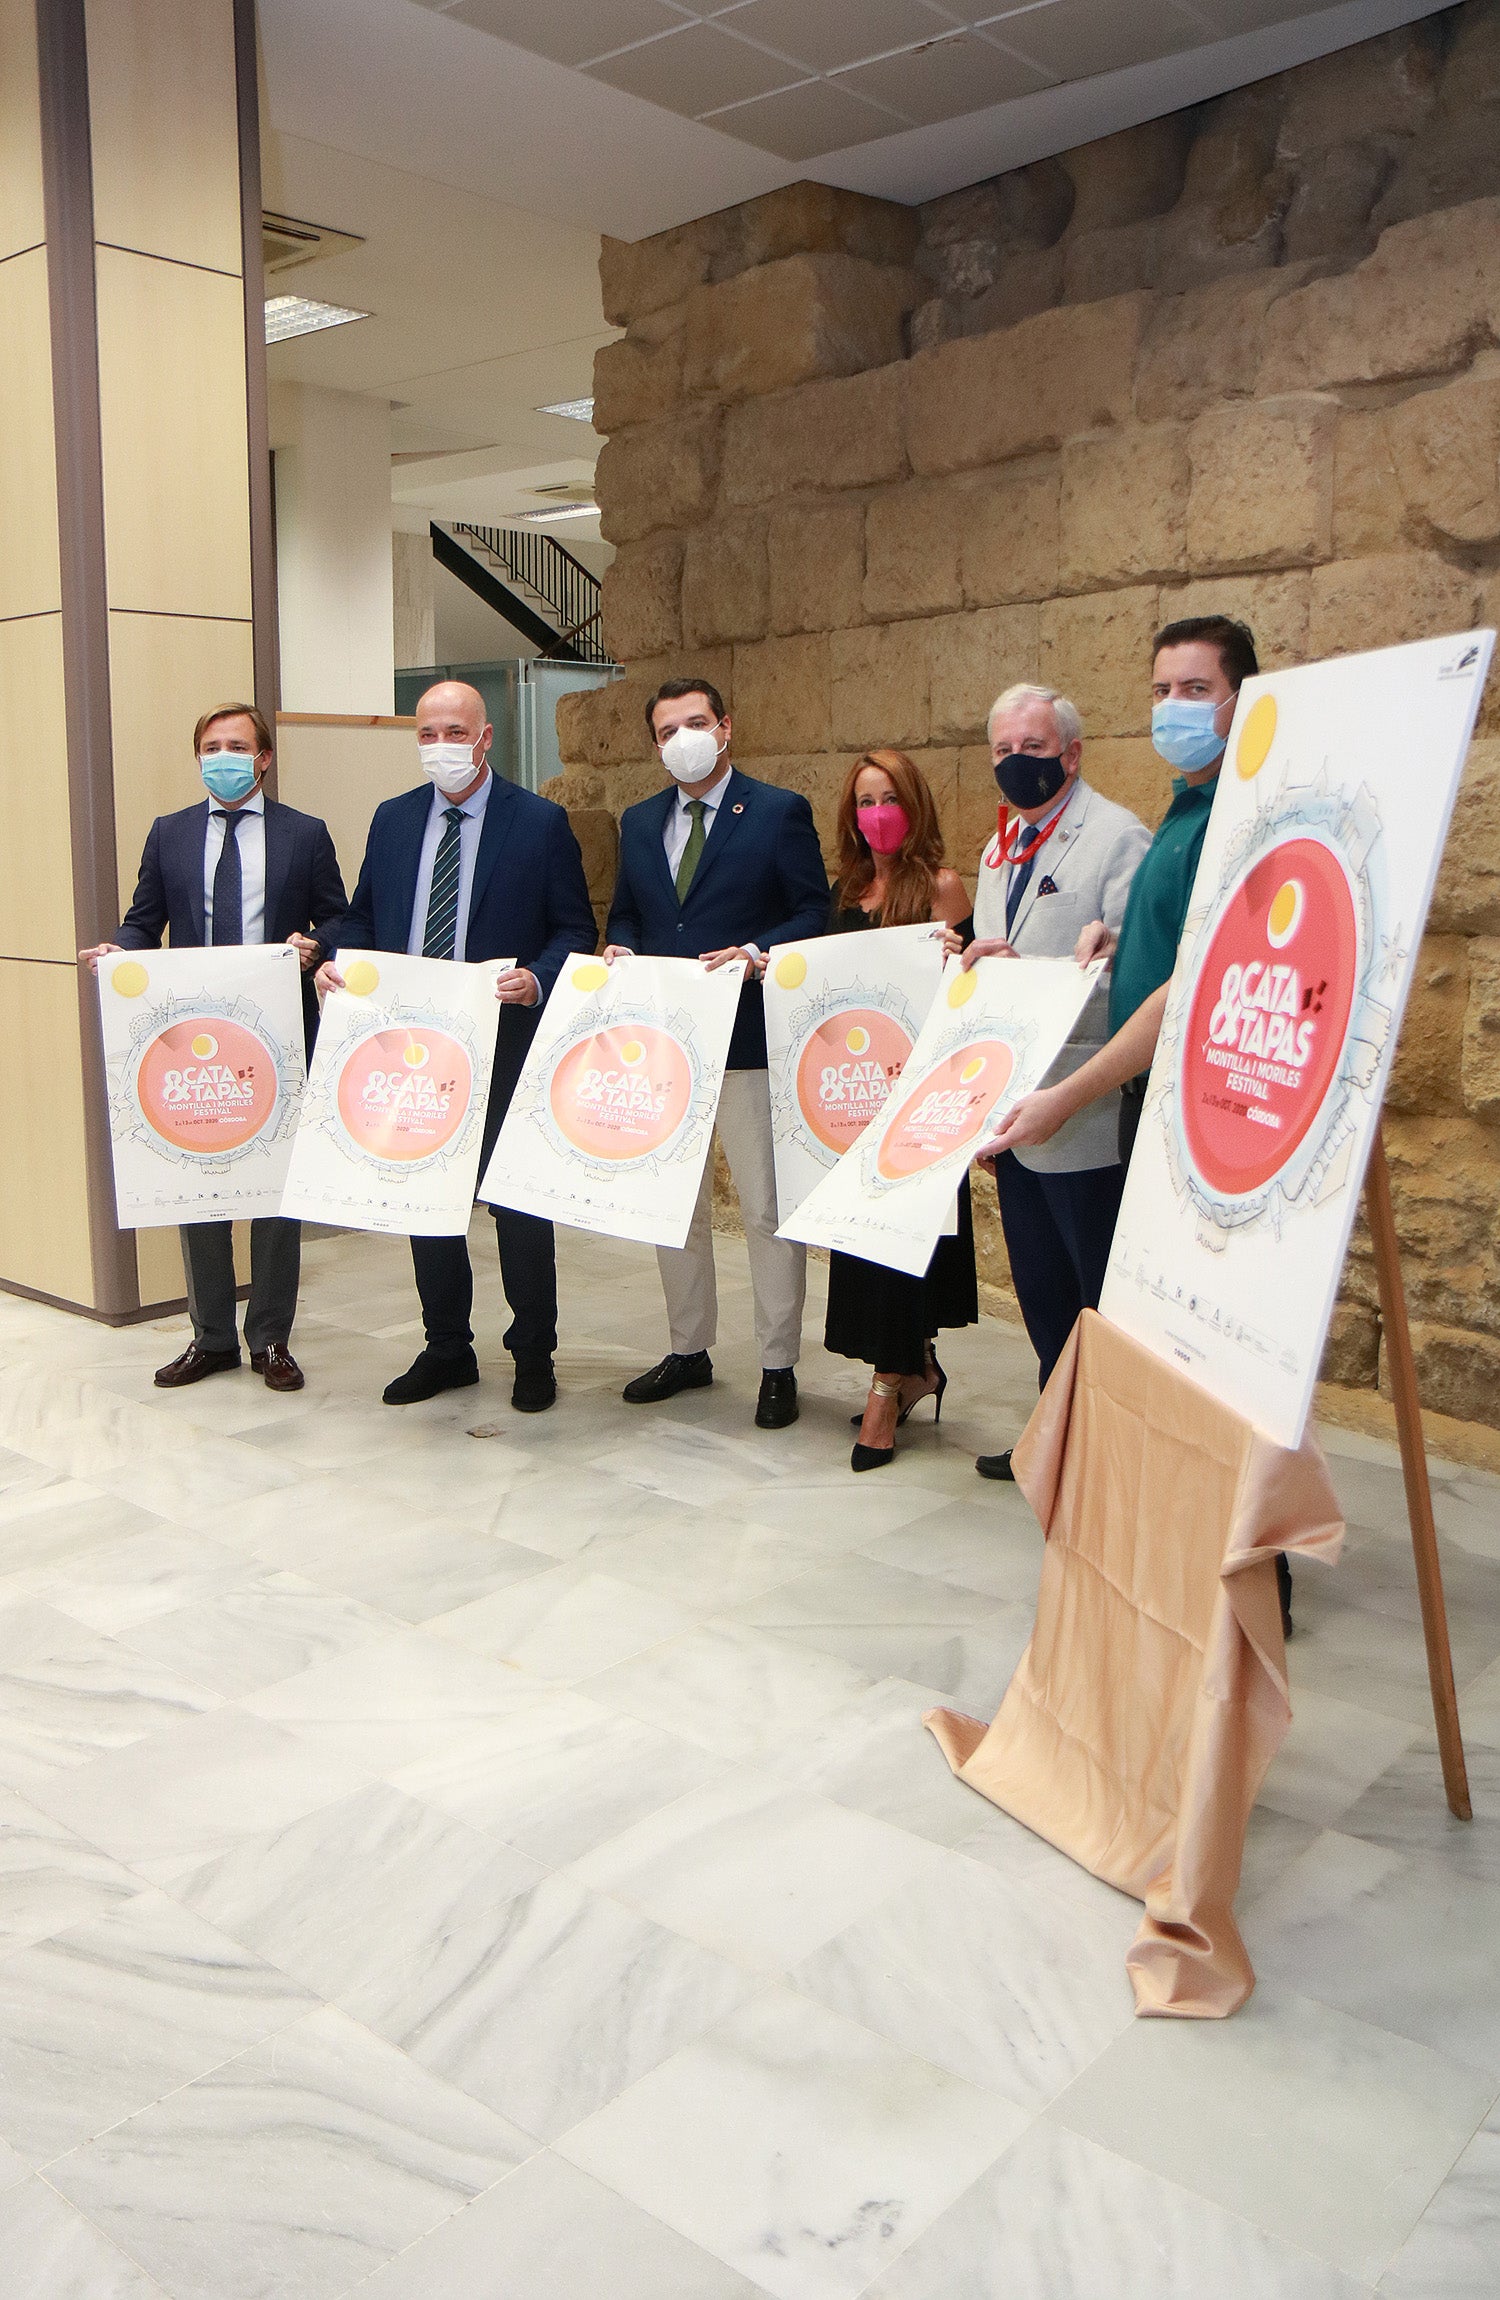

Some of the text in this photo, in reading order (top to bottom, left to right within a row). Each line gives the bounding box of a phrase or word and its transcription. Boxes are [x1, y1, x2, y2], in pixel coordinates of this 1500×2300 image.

[1239, 961, 1299, 1017] CATA
[1238, 1008, 1317, 1068] TAPAS
[183, 1065, 237, 1085] CATA
[838, 1061, 887, 1083] CATA
[1205, 1048, 1250, 1076] MONTILLA
[1258, 1063, 1301, 1089] MORILES
[190, 1081, 255, 1102] TAPAS
[387, 1071, 438, 1094] CATA
[602, 1070, 652, 1095] CATA
[1226, 1072, 1269, 1101] FESTIVAL
[169, 1101, 212, 1111] MONTILLA
[219, 1099, 254, 1107] MORILES
[391, 1090, 451, 1112] TAPAS
[605, 1088, 667, 1114] TAPAS
[825, 1101, 864, 1111] MONTILLA
[935, 1090, 971, 1108] CATA
[193, 1108, 232, 1117] FESTIVAL
[413, 1110, 448, 1119] MORILES
[599, 1112, 637, 1125] FESTIVAL
[625, 1110, 661, 1121] MORILES
[925, 1107, 973, 1126] TAPAS
